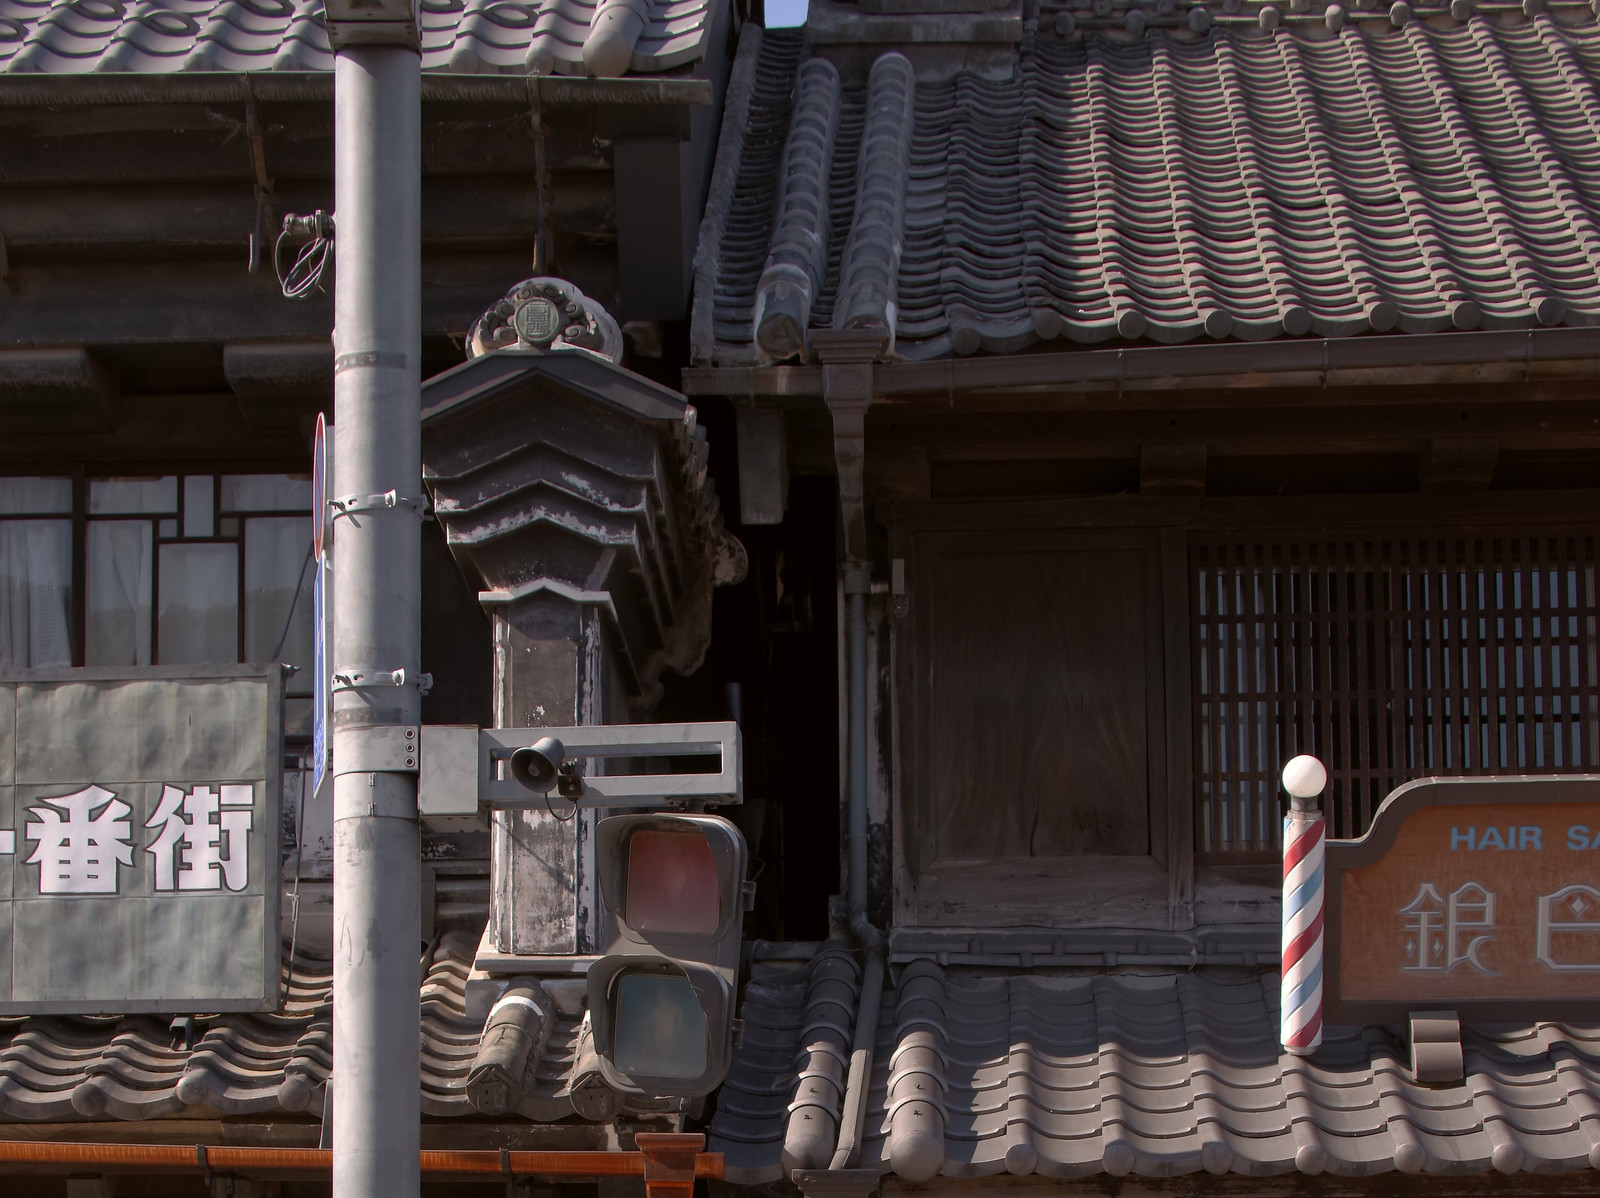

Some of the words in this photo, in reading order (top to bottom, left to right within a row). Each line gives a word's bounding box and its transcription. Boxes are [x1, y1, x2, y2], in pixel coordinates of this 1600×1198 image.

[0, 784, 254, 894] 番街
[1449, 825, 1543, 851] HAIR
[1566, 824, 1600, 851] S
